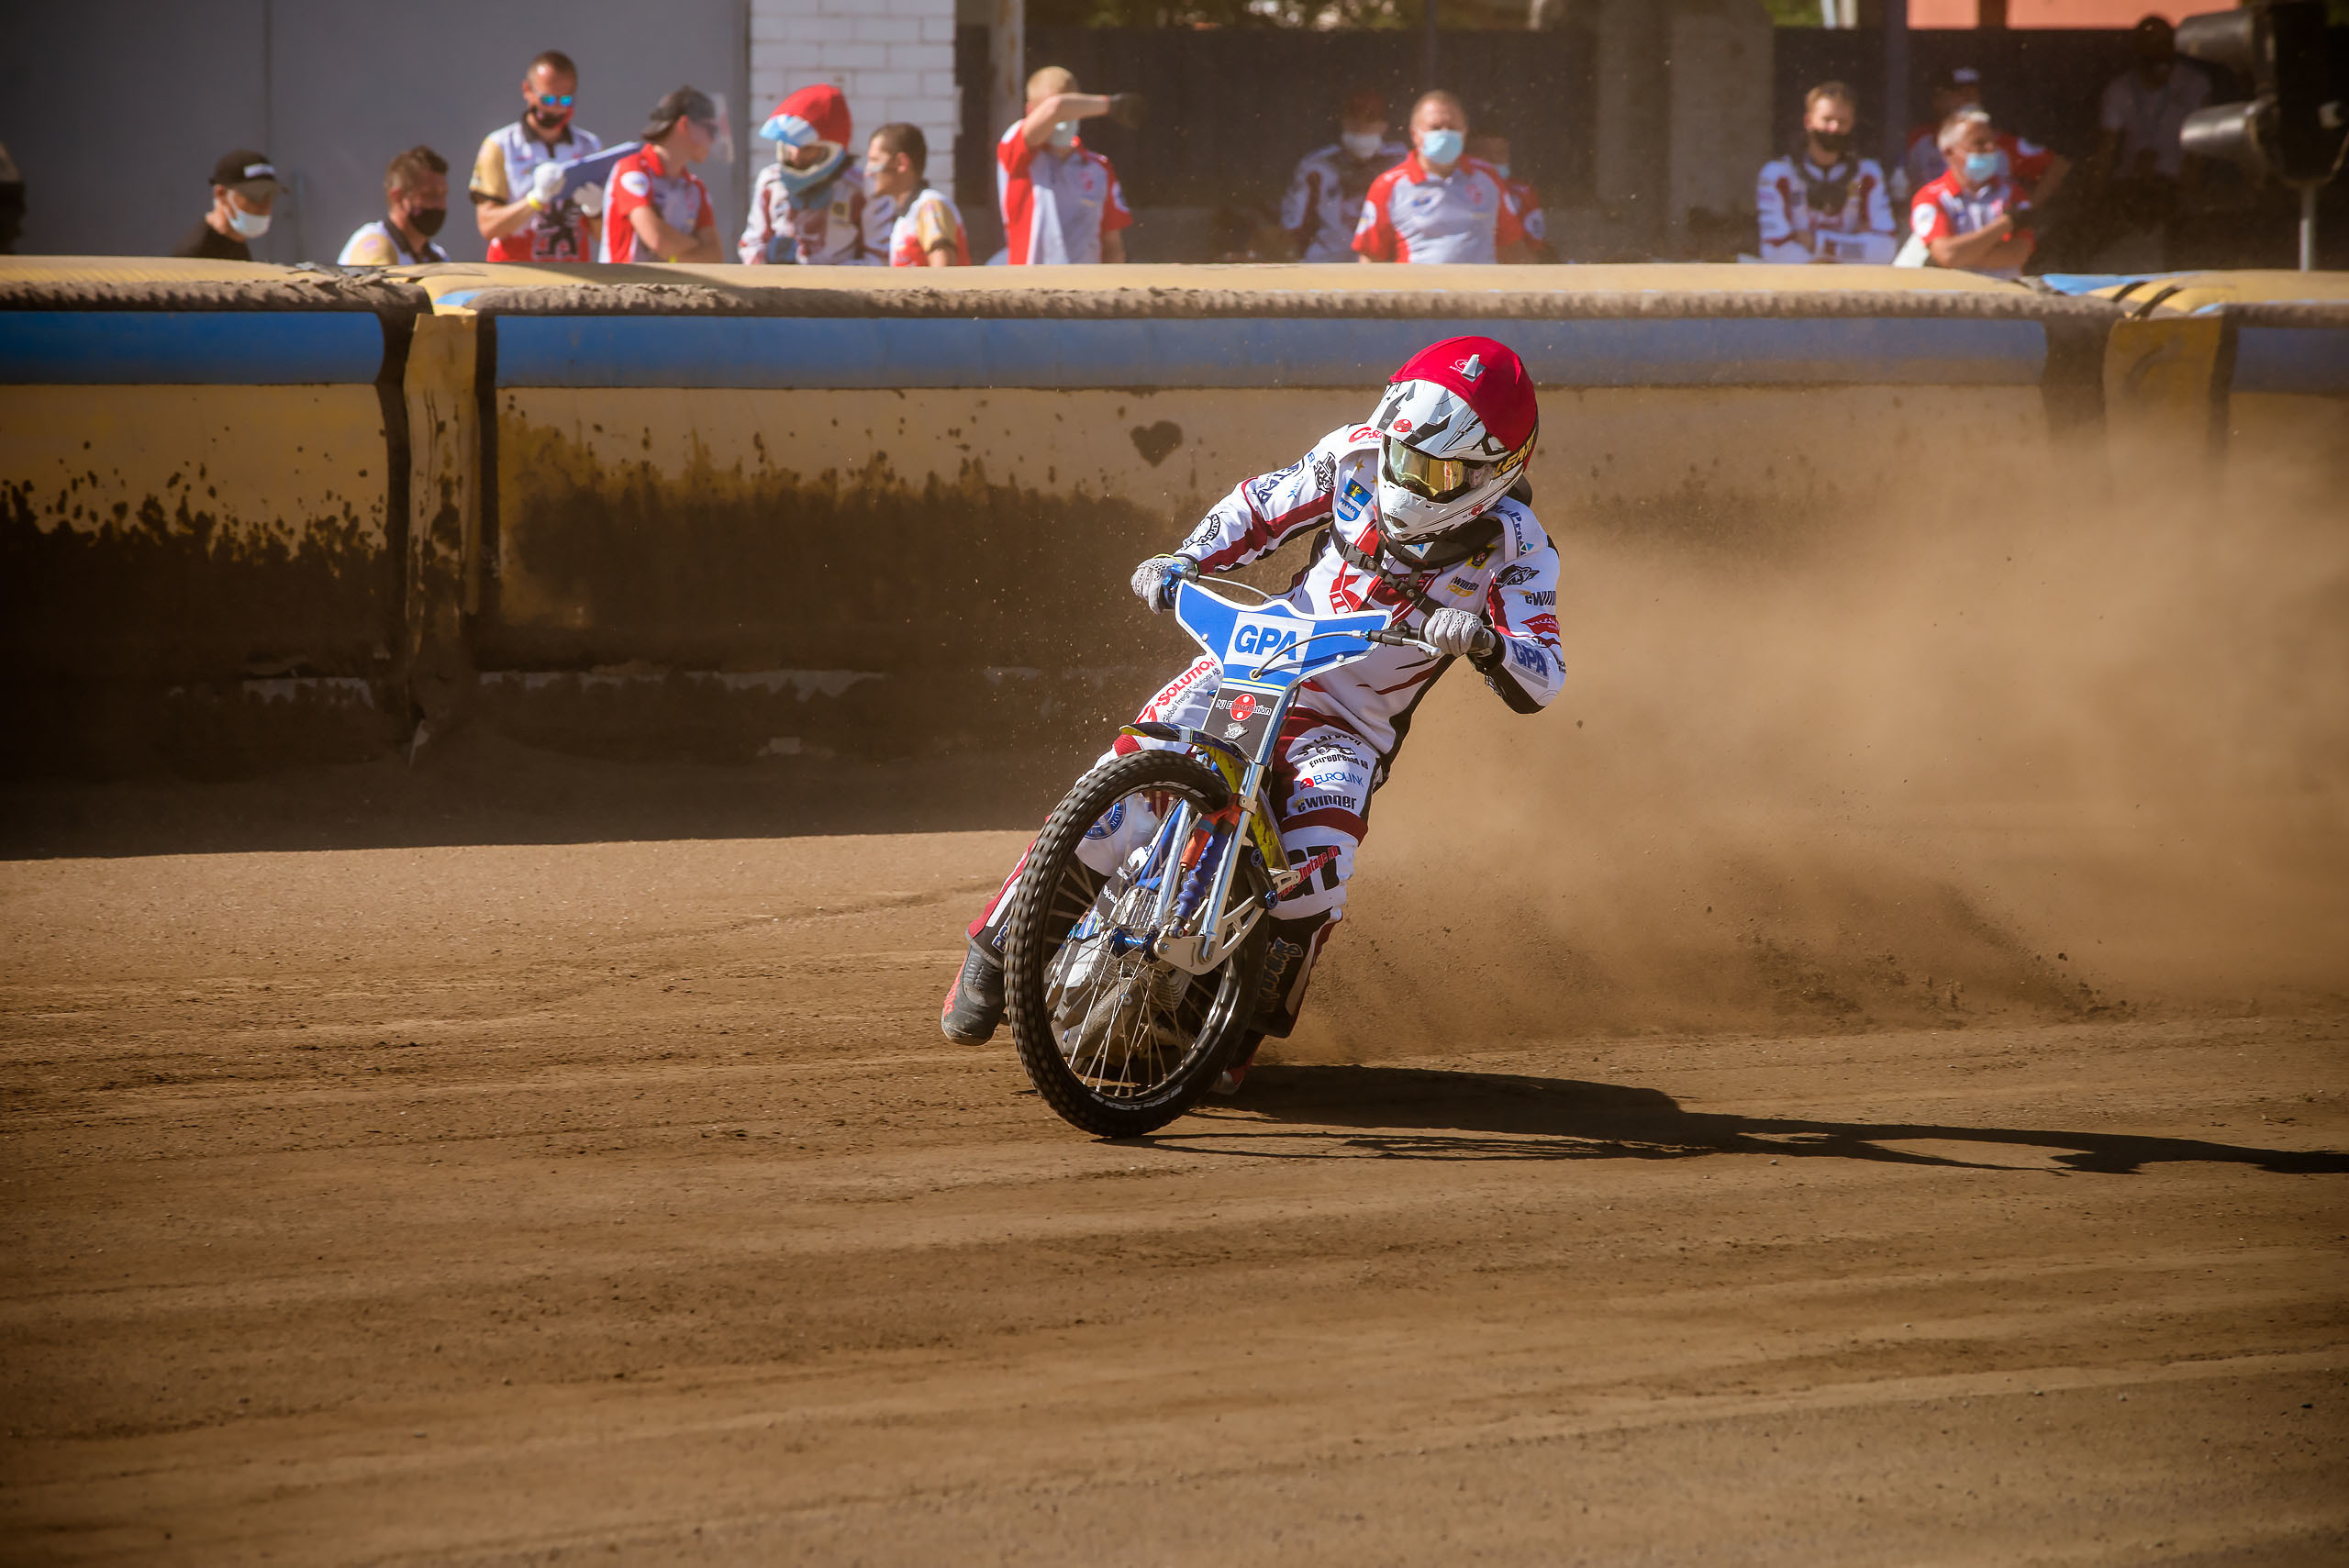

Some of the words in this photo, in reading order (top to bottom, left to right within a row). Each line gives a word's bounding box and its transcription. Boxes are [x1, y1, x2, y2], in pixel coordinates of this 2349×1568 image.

[1234, 625, 1296, 661] GPA
[1512, 640, 1548, 677] GPA
[1313, 772, 1364, 787] EUROLINK
